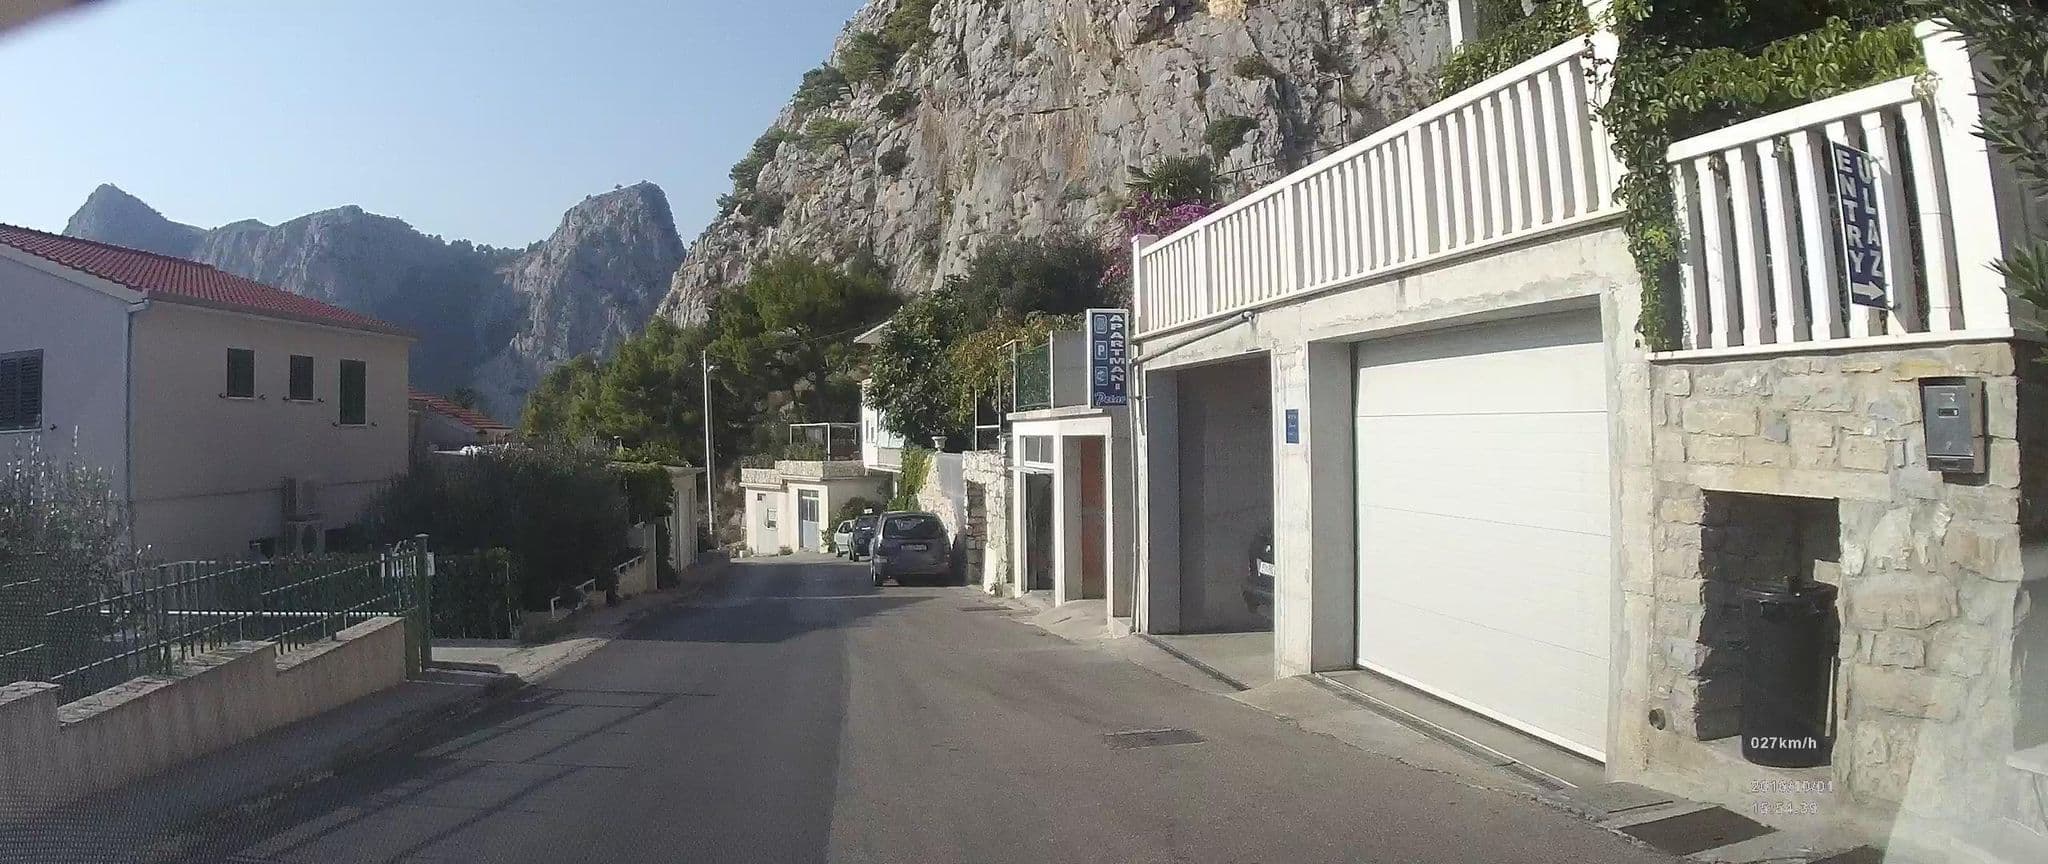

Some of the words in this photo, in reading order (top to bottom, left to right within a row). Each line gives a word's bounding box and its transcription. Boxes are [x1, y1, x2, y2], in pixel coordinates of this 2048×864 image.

[1836, 149, 1864, 273] ENTRY
[1857, 156, 1883, 277] ULAZ
[1097, 344, 1105, 356] P
[1109, 314, 1125, 390] APARTMANI
